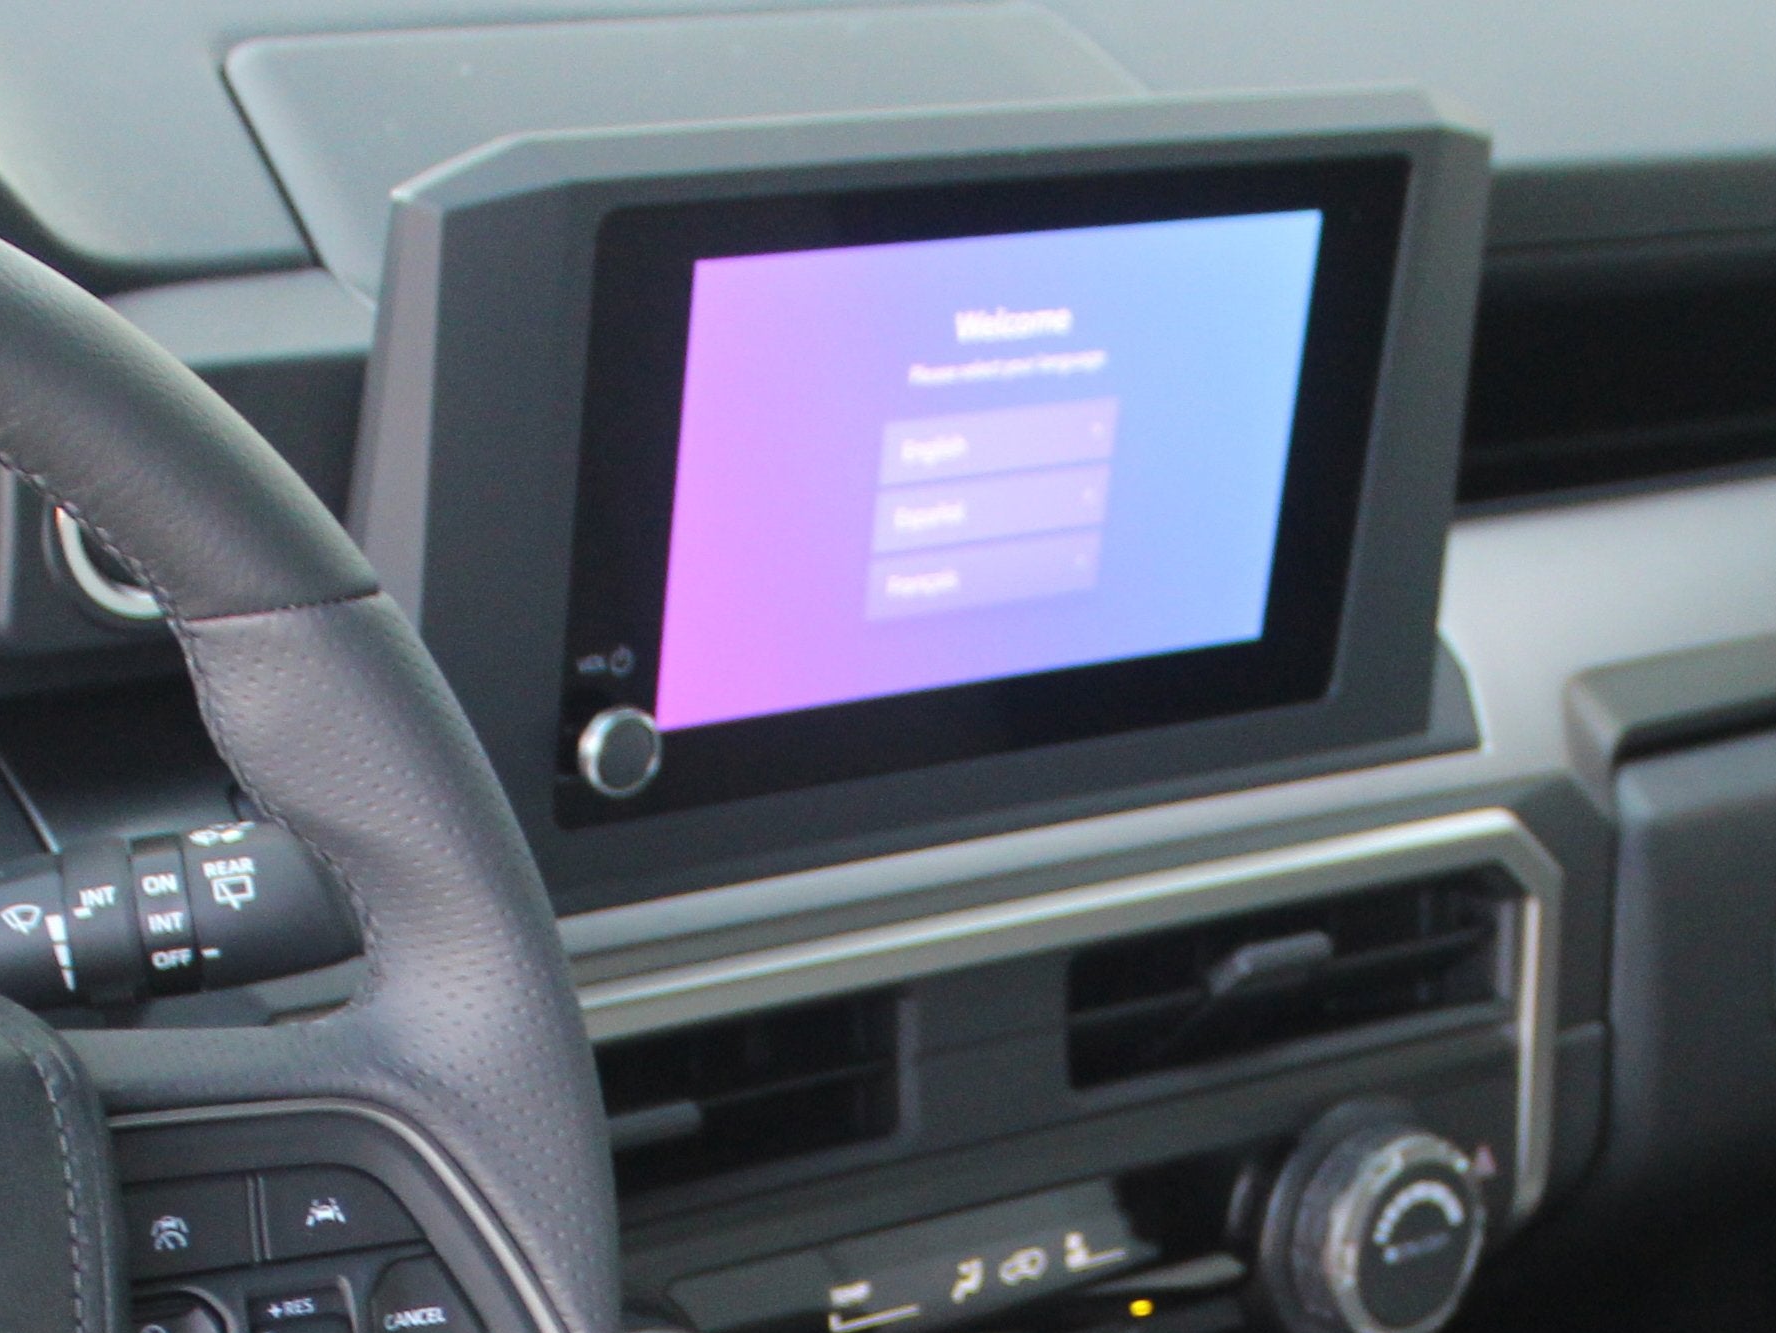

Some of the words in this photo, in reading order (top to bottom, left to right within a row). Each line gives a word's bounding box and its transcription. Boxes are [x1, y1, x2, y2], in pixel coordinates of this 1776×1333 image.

[954, 306, 1072, 343] Welcome
[202, 857, 256, 879] REAR
[141, 874, 178, 896] ON
[79, 885, 116, 909] INT
[147, 911, 184, 934] INT
[151, 948, 193, 970] OFF
[383, 1306, 448, 1332] CANCEL
